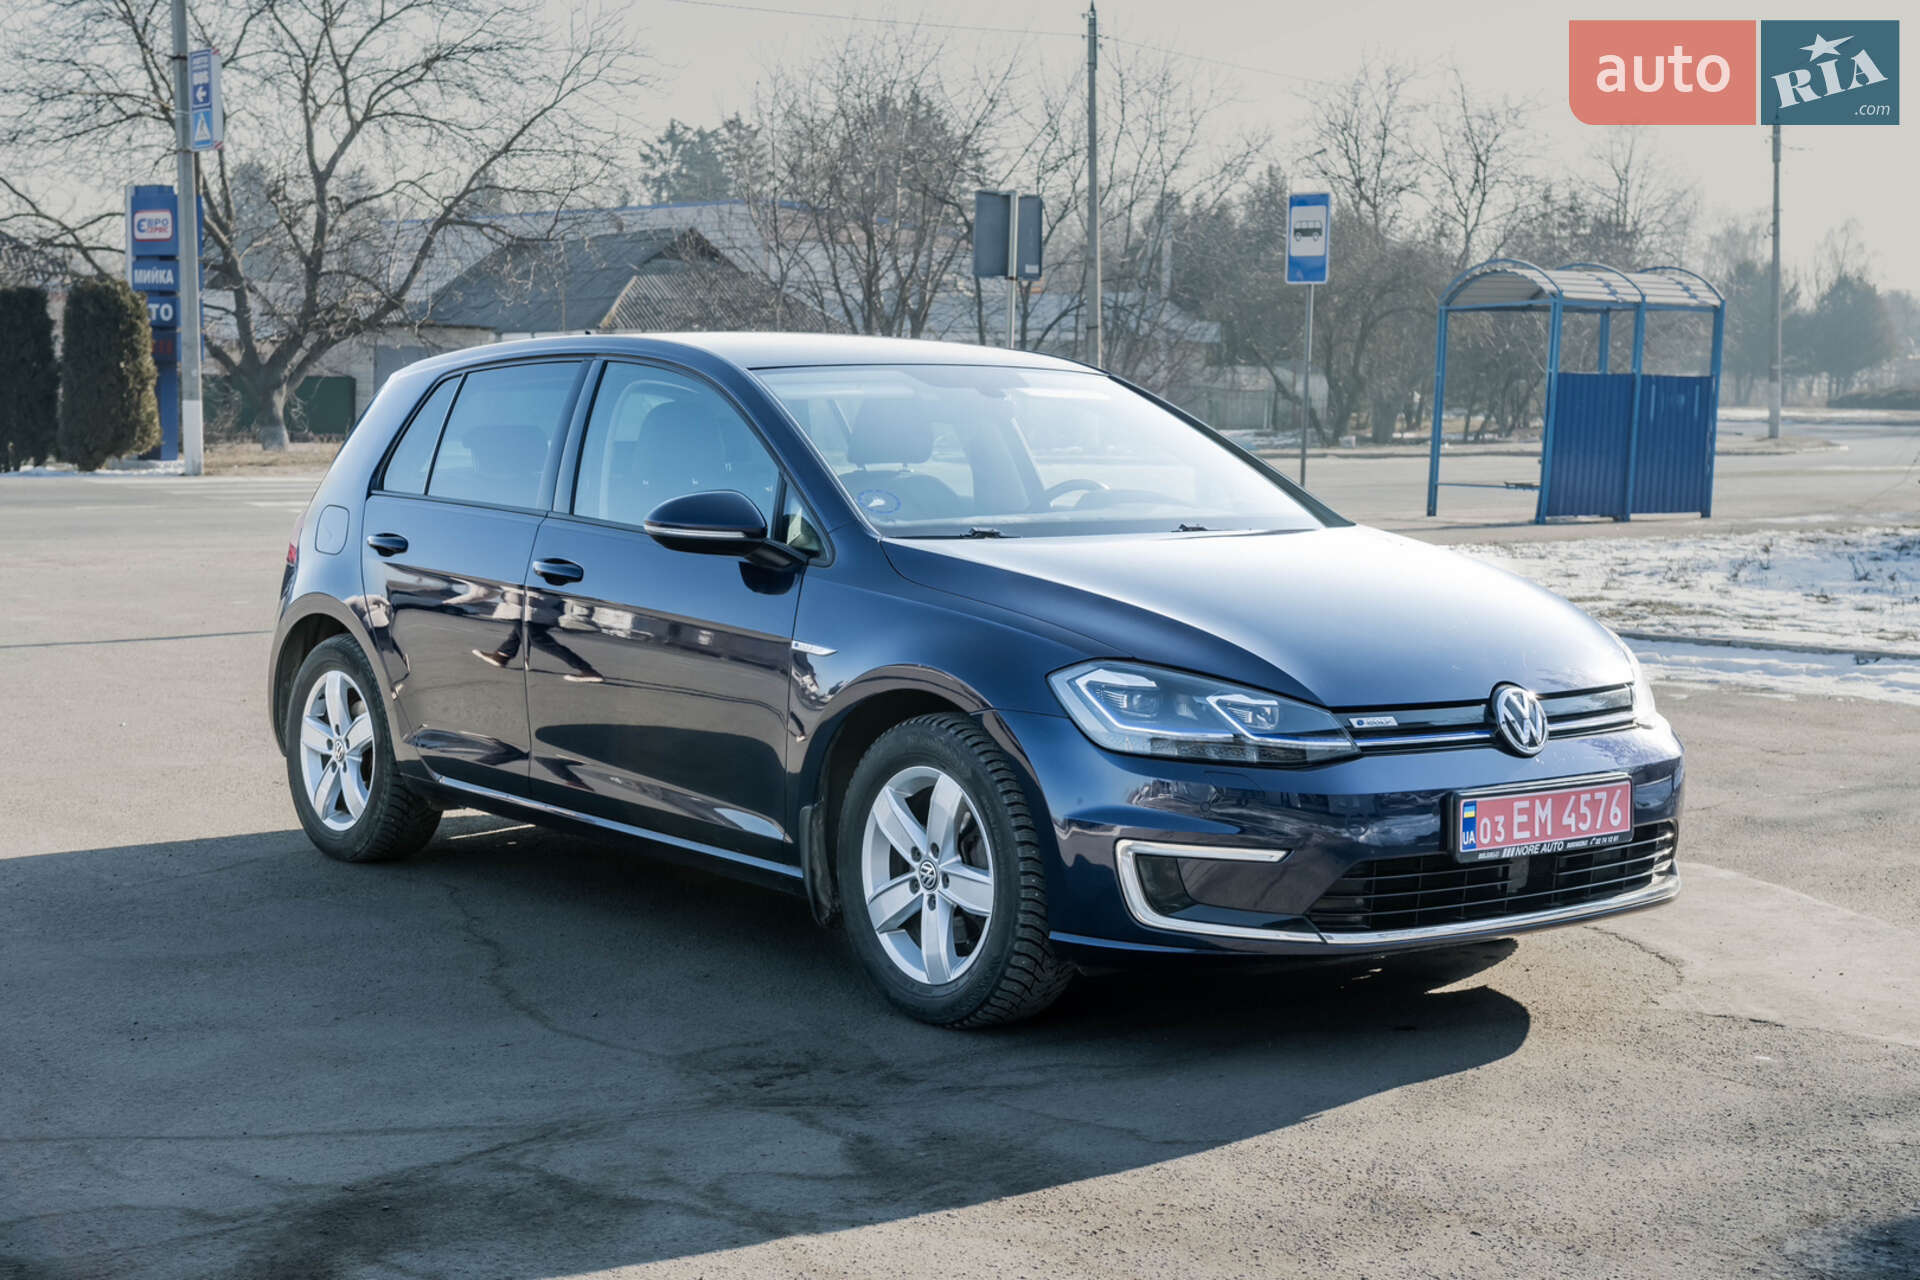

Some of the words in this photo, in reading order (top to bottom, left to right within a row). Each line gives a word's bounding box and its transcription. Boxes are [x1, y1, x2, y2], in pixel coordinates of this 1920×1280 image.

[134, 266, 174, 285] МИЙКА
[1479, 815, 1506, 845] 03
[1512, 799, 1553, 840] EM
[1562, 789, 1623, 833] 4576
[1462, 830, 1476, 846] UA
[1540, 841, 1564, 853] AUTO
